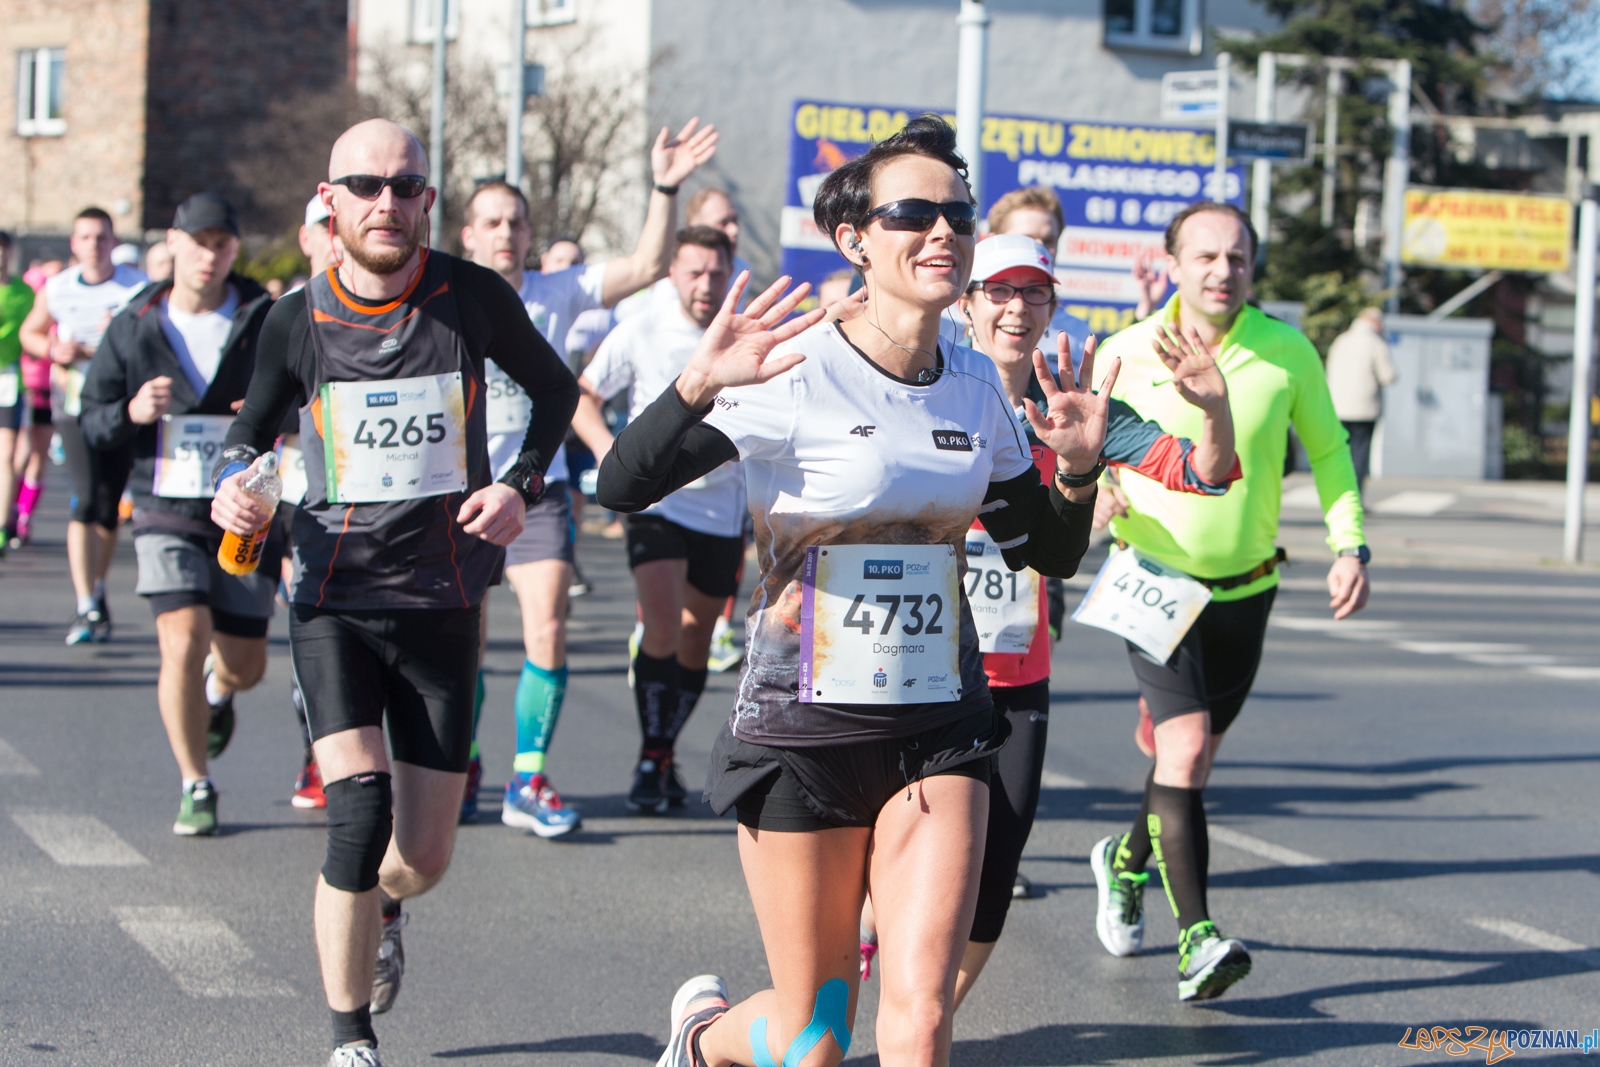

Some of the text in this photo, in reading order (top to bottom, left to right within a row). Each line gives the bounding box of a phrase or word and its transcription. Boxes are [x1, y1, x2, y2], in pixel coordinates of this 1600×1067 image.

[981, 117, 1218, 167] ZĘTU ZIMOWEG
[489, 379, 518, 399] 58
[380, 394, 396, 404] PKO
[353, 412, 446, 449] 4265
[850, 425, 876, 437] 4F
[937, 436, 950, 445] 10.
[950, 436, 968, 446] PKO
[386, 451, 419, 463] Michał
[968, 544, 982, 553] PKO
[868, 565, 880, 574] 10.
[881, 565, 901, 574] PKO
[967, 567, 1017, 602] 781
[1113, 572, 1178, 621] 4104
[843, 593, 943, 636] 4732
[873, 643, 925, 657] Dagmara
[903, 678, 917, 688] 4F
